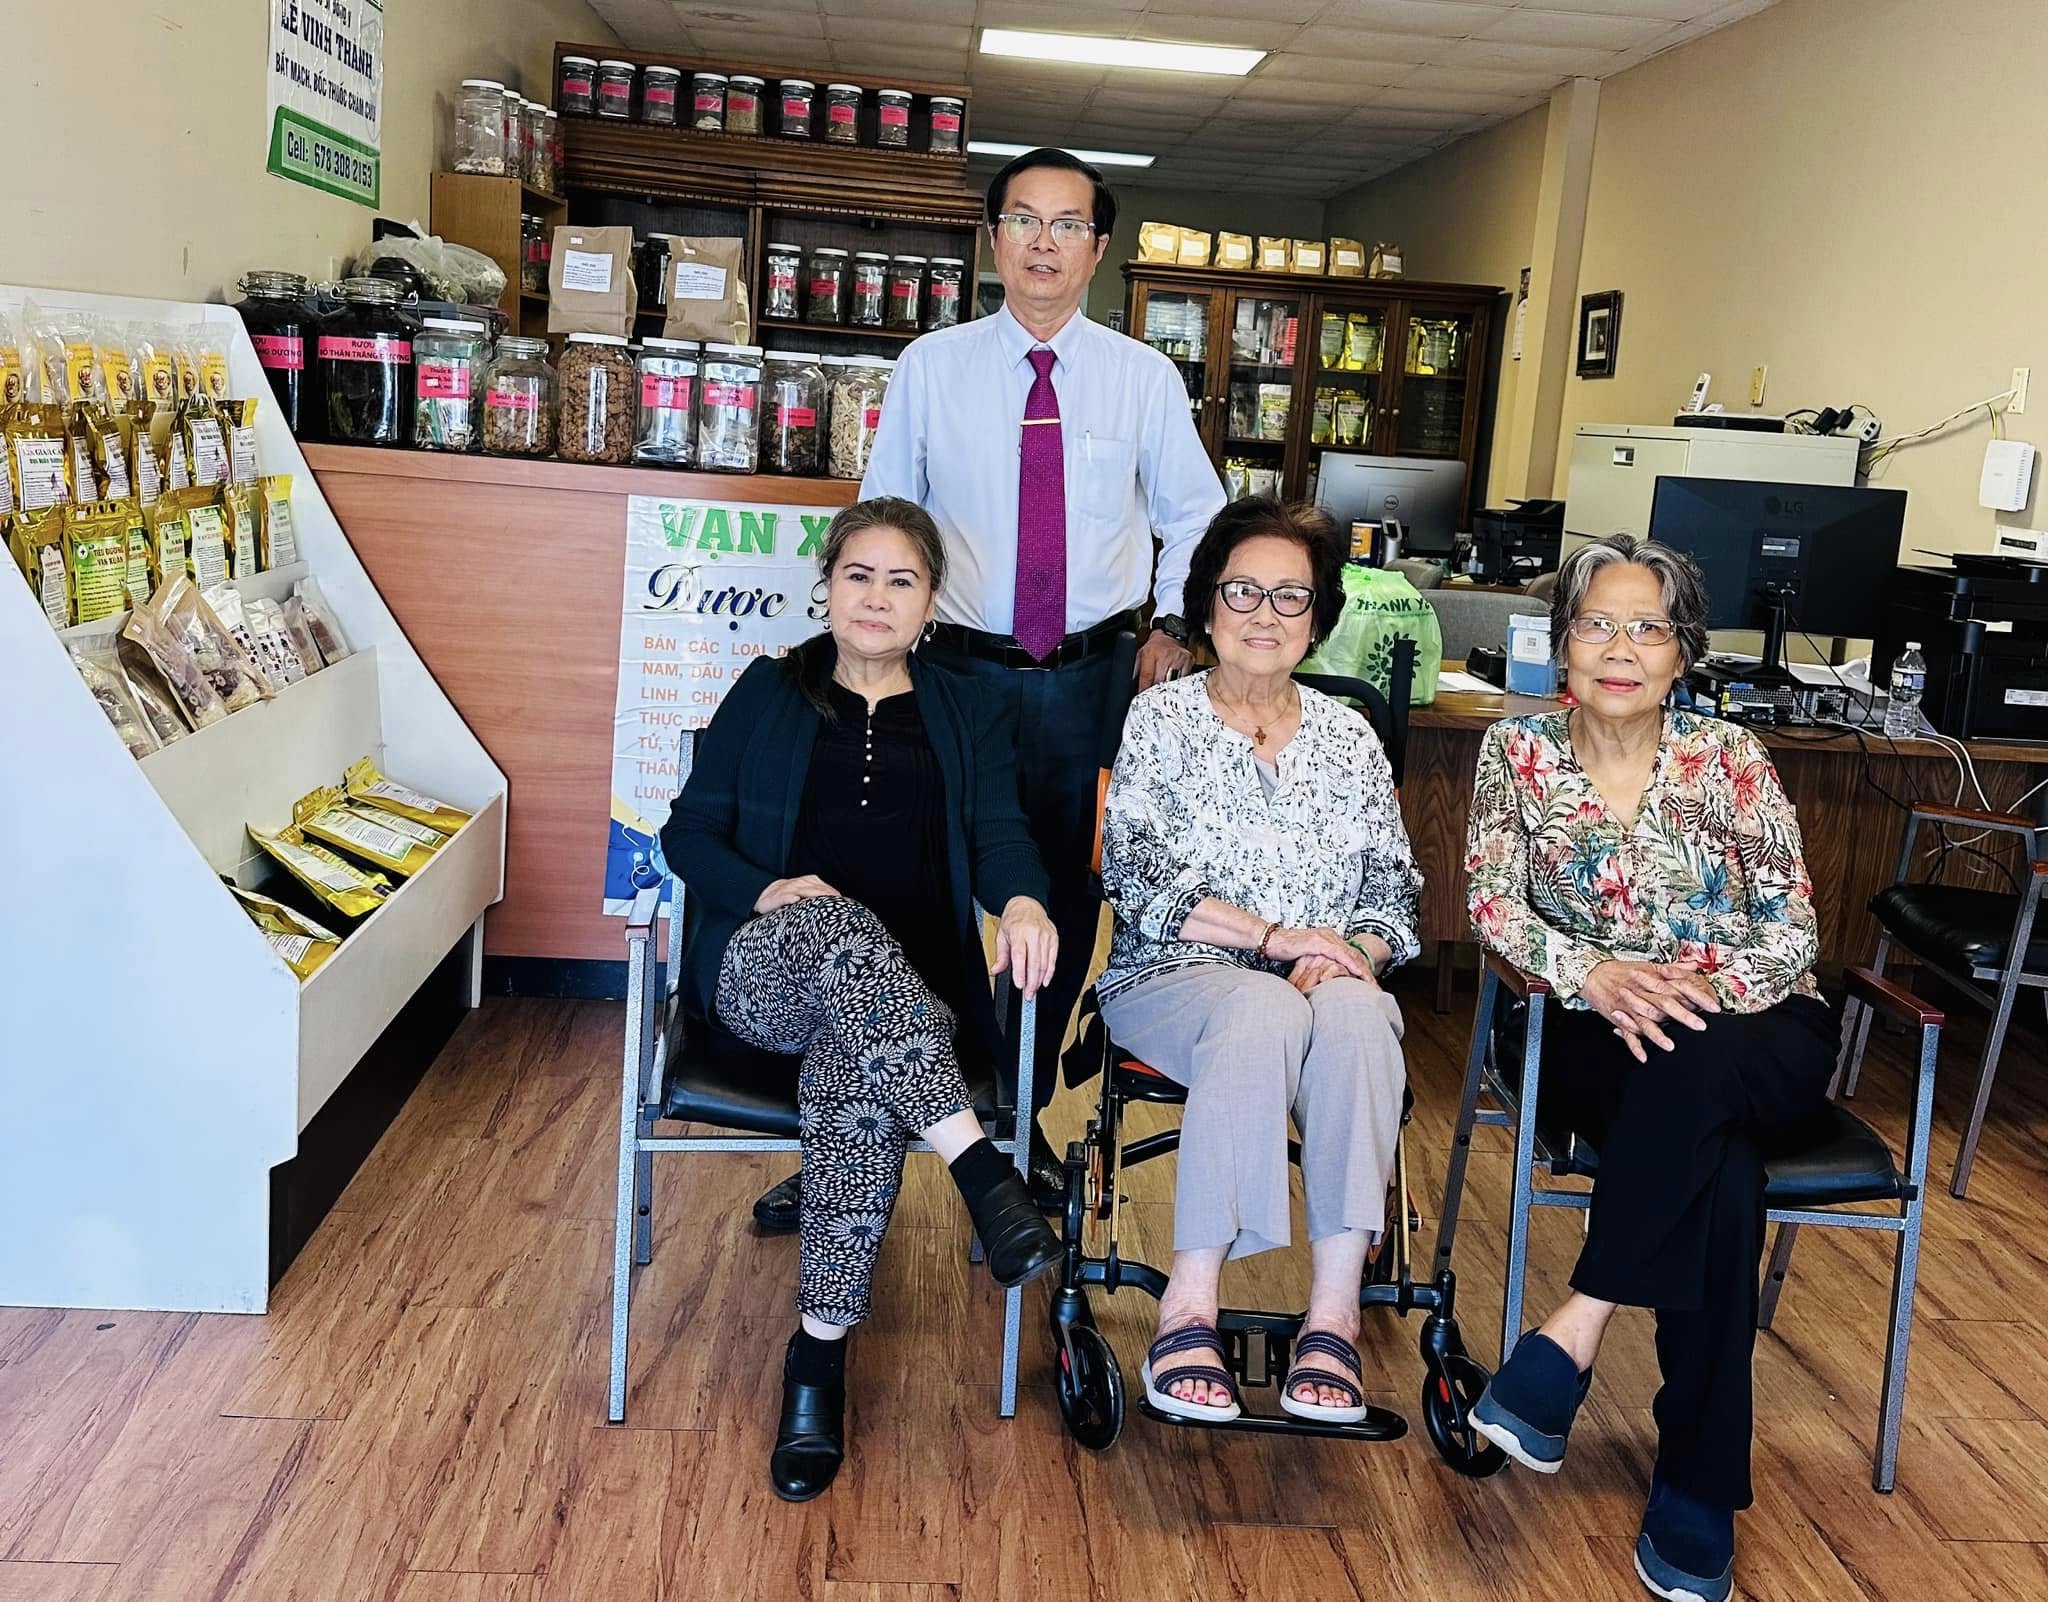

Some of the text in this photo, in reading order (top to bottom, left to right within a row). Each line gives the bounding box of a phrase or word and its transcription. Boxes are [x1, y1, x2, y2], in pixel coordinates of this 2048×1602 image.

[287, 131, 372, 188] Cell: 678 308 2153
[658, 503, 777, 560] VẠN
[1356, 598, 1412, 612] THANK
[688, 636, 720, 655] CÁC
[642, 661, 683, 680] NAM,
[640, 686, 679, 701] LINH
[639, 711, 683, 729] THỰC
